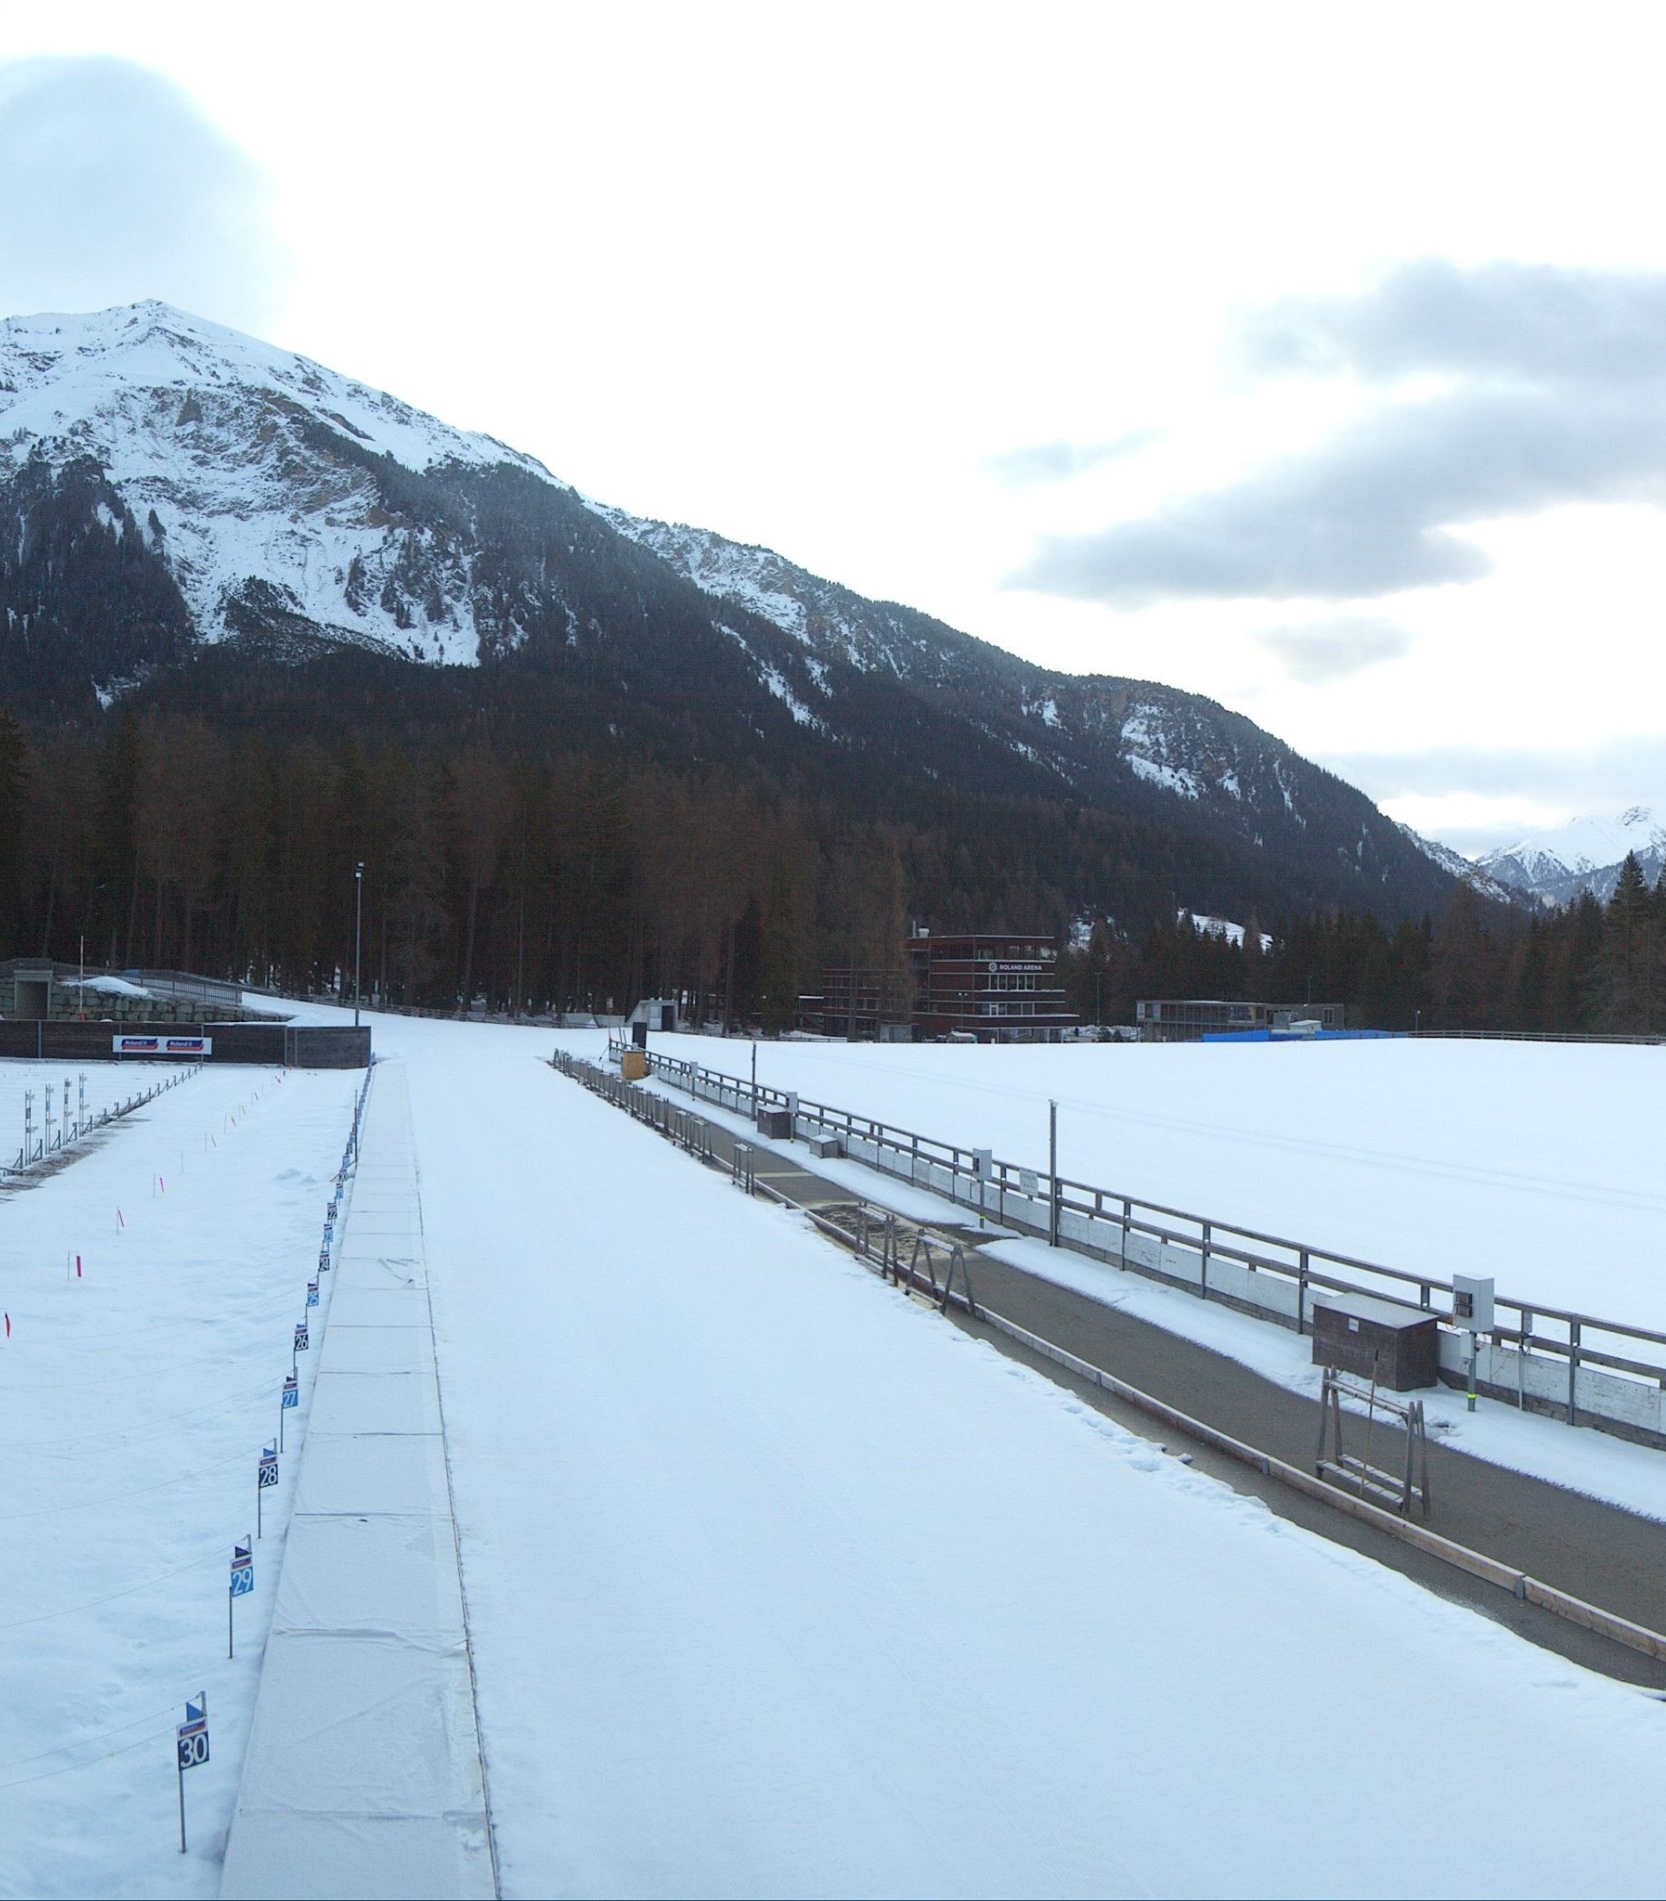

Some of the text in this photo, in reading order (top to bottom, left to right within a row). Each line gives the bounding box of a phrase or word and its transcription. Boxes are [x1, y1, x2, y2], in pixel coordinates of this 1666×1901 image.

[308, 1292, 319, 1306] 25
[295, 1335, 308, 1350] 26
[283, 1391, 297, 1408] 27
[260, 1465, 278, 1487] 28
[232, 1568, 253, 1595] 29
[179, 1733, 208, 1768] 30
